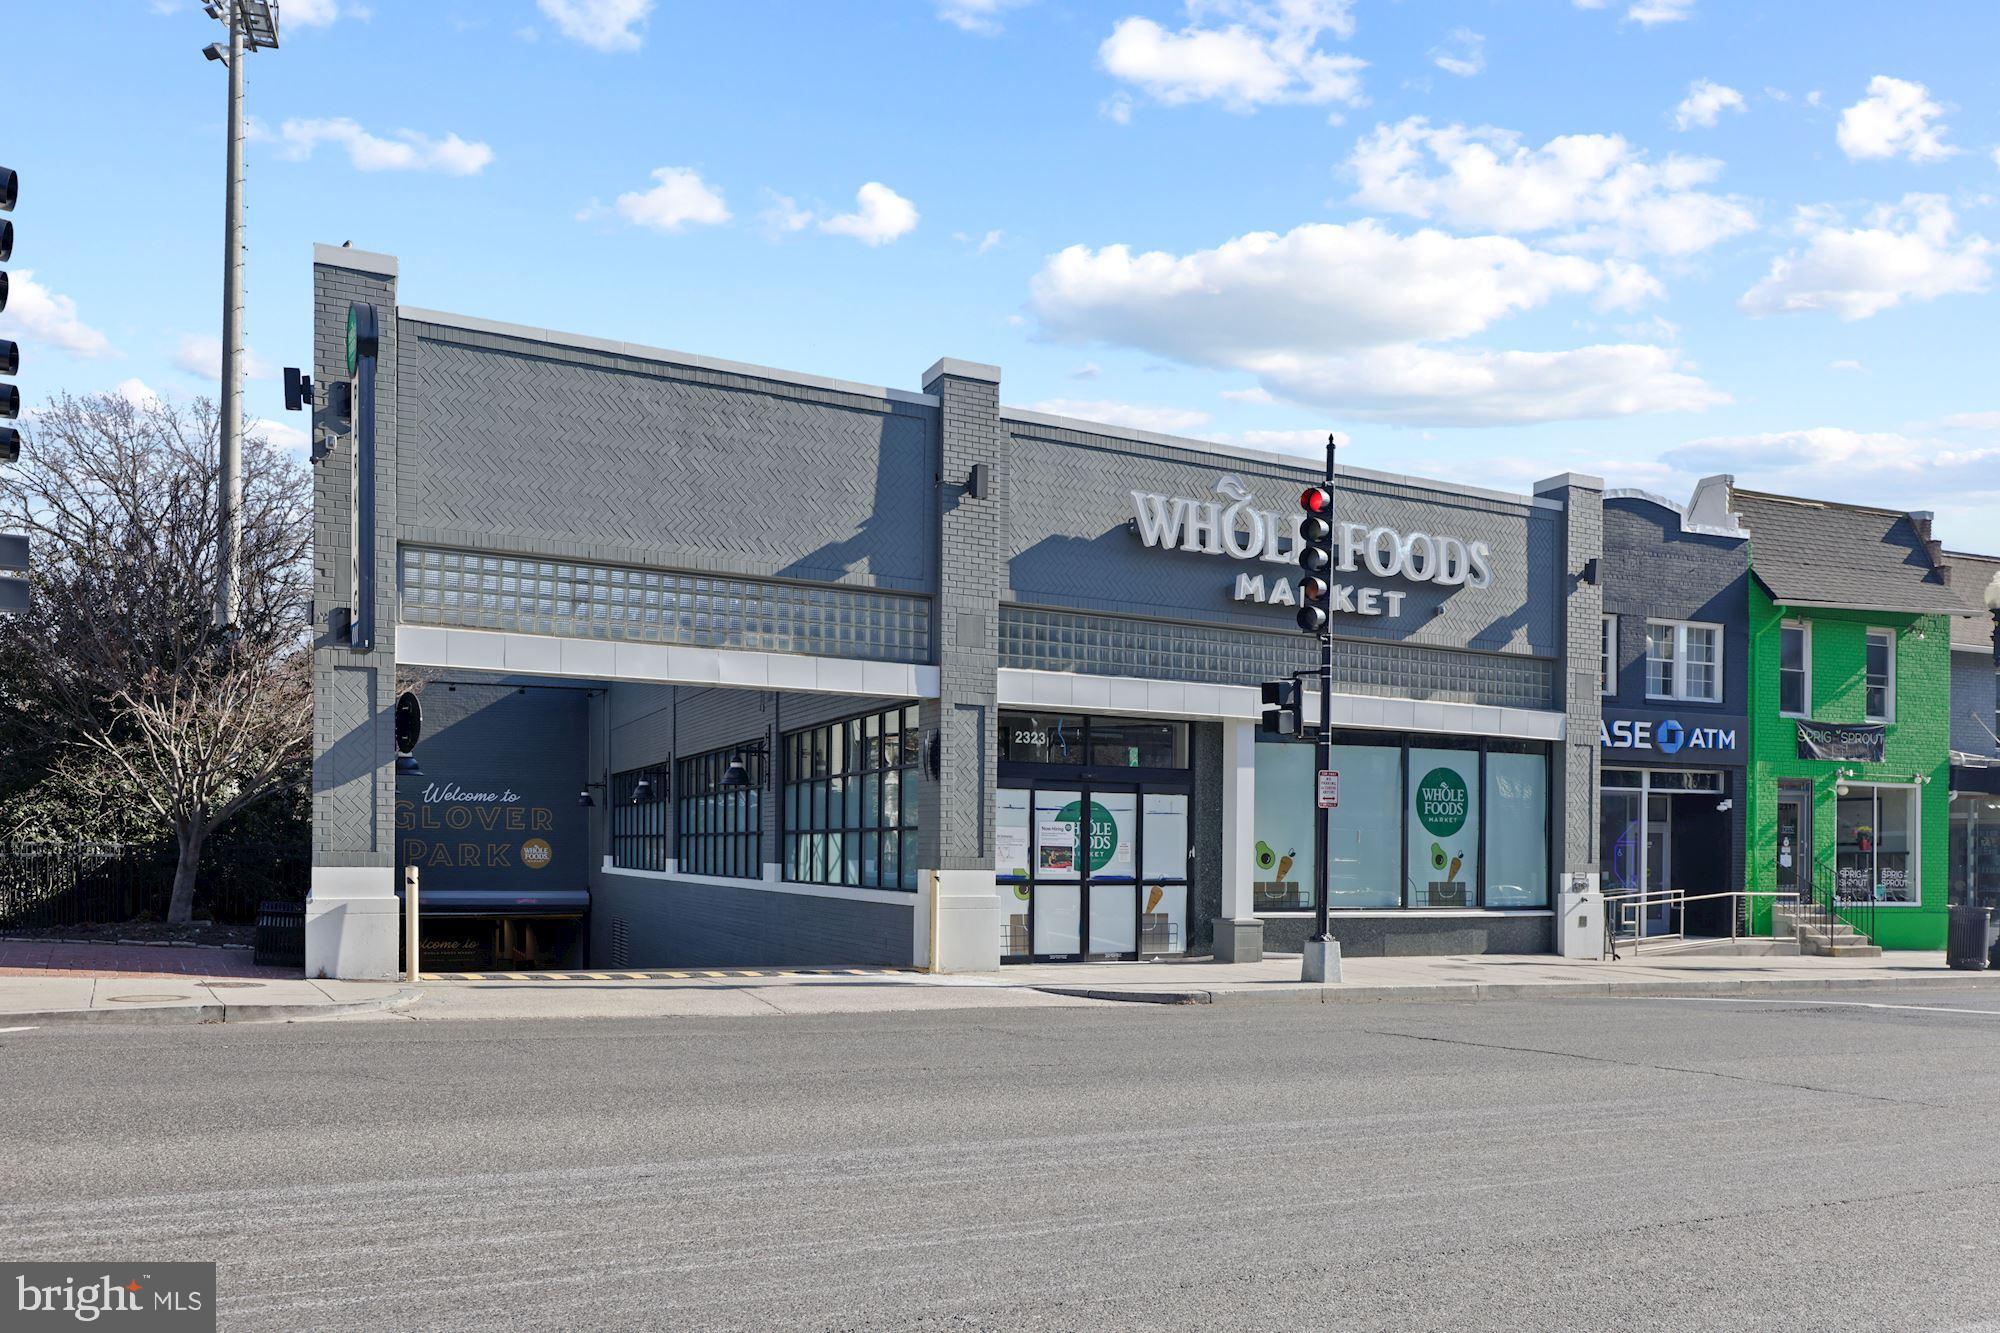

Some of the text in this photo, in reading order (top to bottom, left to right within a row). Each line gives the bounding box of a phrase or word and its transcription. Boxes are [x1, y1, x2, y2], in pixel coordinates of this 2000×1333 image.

[1335, 521, 1495, 590] FOODS
[1234, 572, 1407, 618] MAKET
[1014, 730, 1046, 744] 2323
[1600, 719, 1736, 750] ASE ATM
[1840, 731, 1885, 745] SPROUT
[421, 782, 521, 803] Welcome to
[1421, 786, 1465, 802] WHOLE
[395, 800, 553, 831] GLOVER
[1424, 801, 1464, 816] FOODS
[1074, 822, 1112, 836] HOLE
[403, 838, 513, 867] PARK
[1881, 870, 1904, 879] SPRIG
